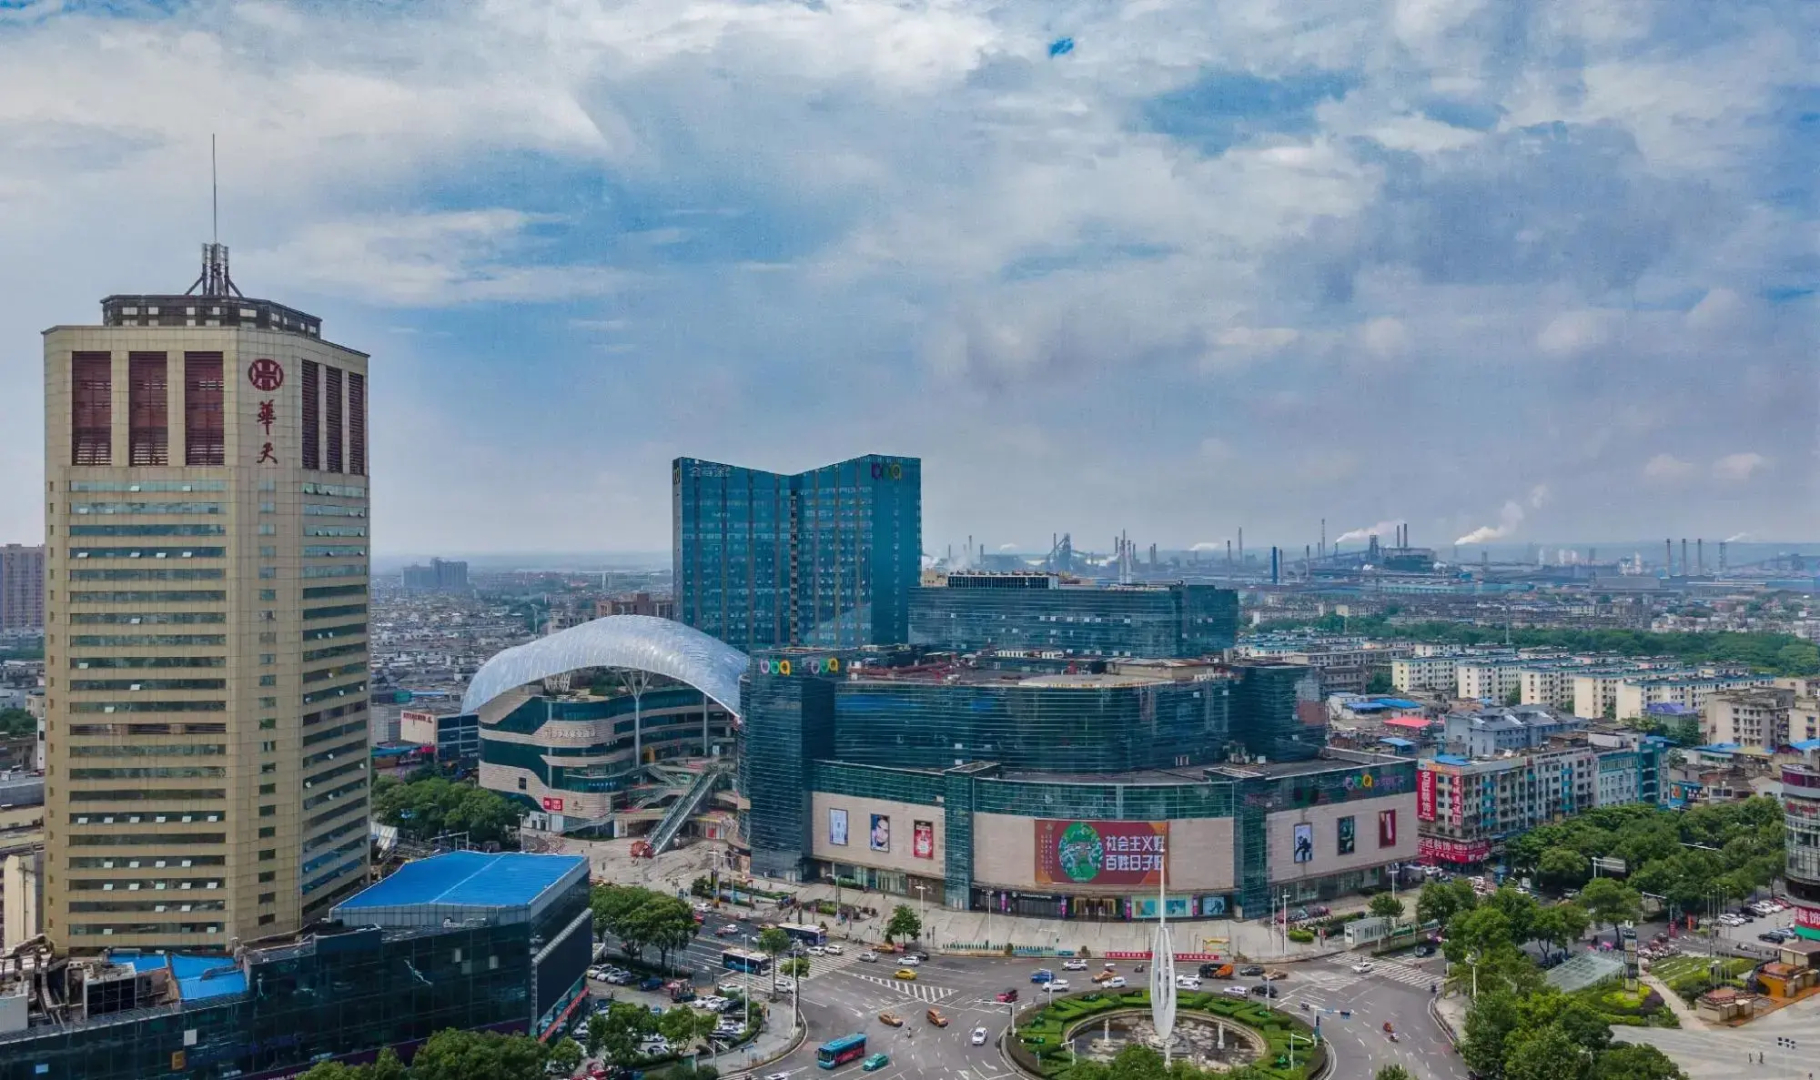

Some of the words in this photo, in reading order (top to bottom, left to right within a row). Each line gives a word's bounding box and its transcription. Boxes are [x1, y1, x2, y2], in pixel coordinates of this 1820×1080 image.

[1105, 835, 1165, 852] 社会主义好
[1105, 854, 1164, 871] 百姓日子好
